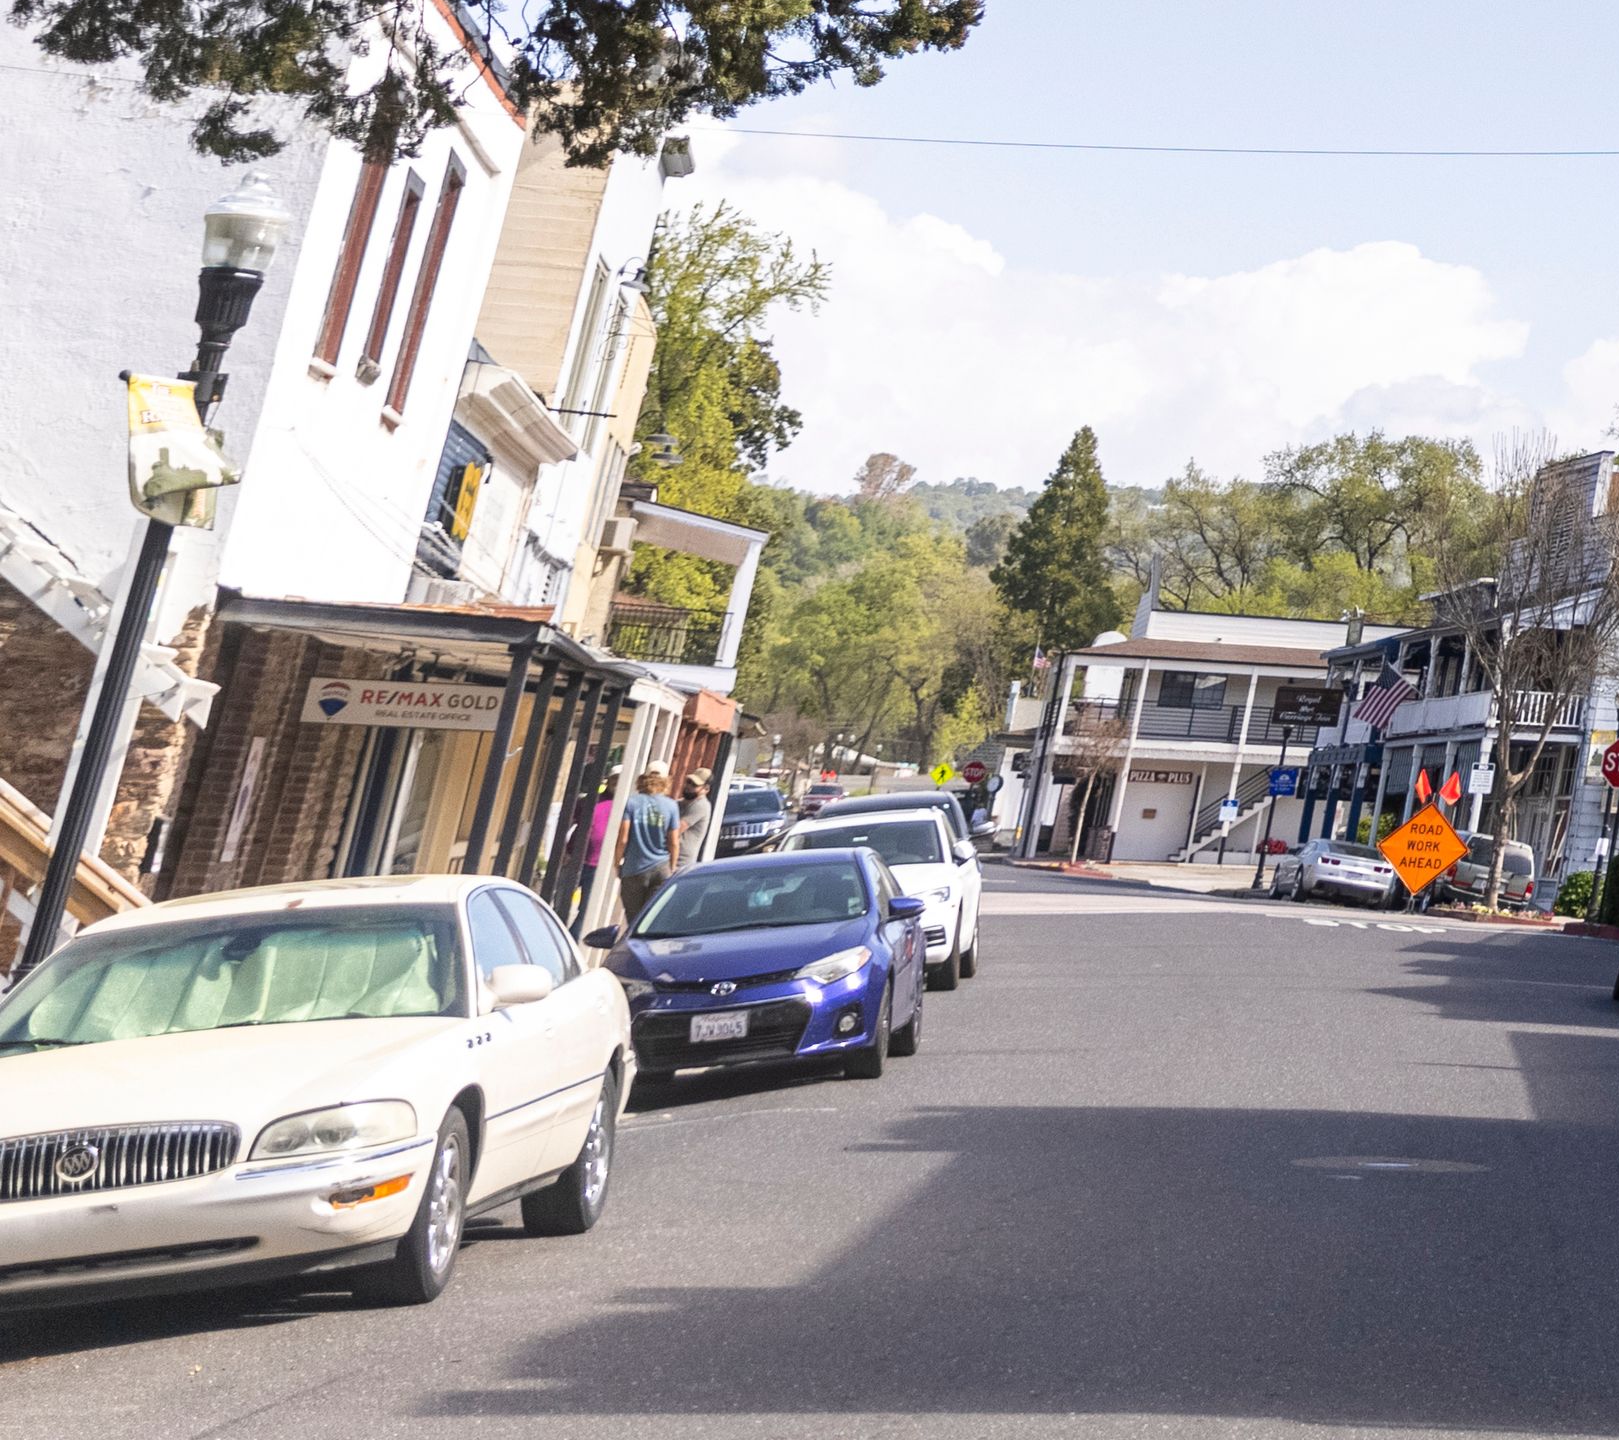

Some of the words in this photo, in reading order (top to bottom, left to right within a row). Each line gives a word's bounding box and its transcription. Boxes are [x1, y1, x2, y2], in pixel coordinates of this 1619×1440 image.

[360, 689, 444, 708] RE/MAX
[447, 694, 499, 711] GOLD
[375, 709, 399, 718] REAL
[401, 710, 437, 720] ESTATE
[438, 712, 472, 722] OFFICE
[964, 768, 985, 777] STOP
[1129, 770, 1155, 782] PIZZA
[1168, 773, 1191, 784] PLUS
[1410, 823, 1444, 836] ROAD
[1407, 840, 1440, 852] WORK
[1399, 857, 1442, 869] AHEAD
